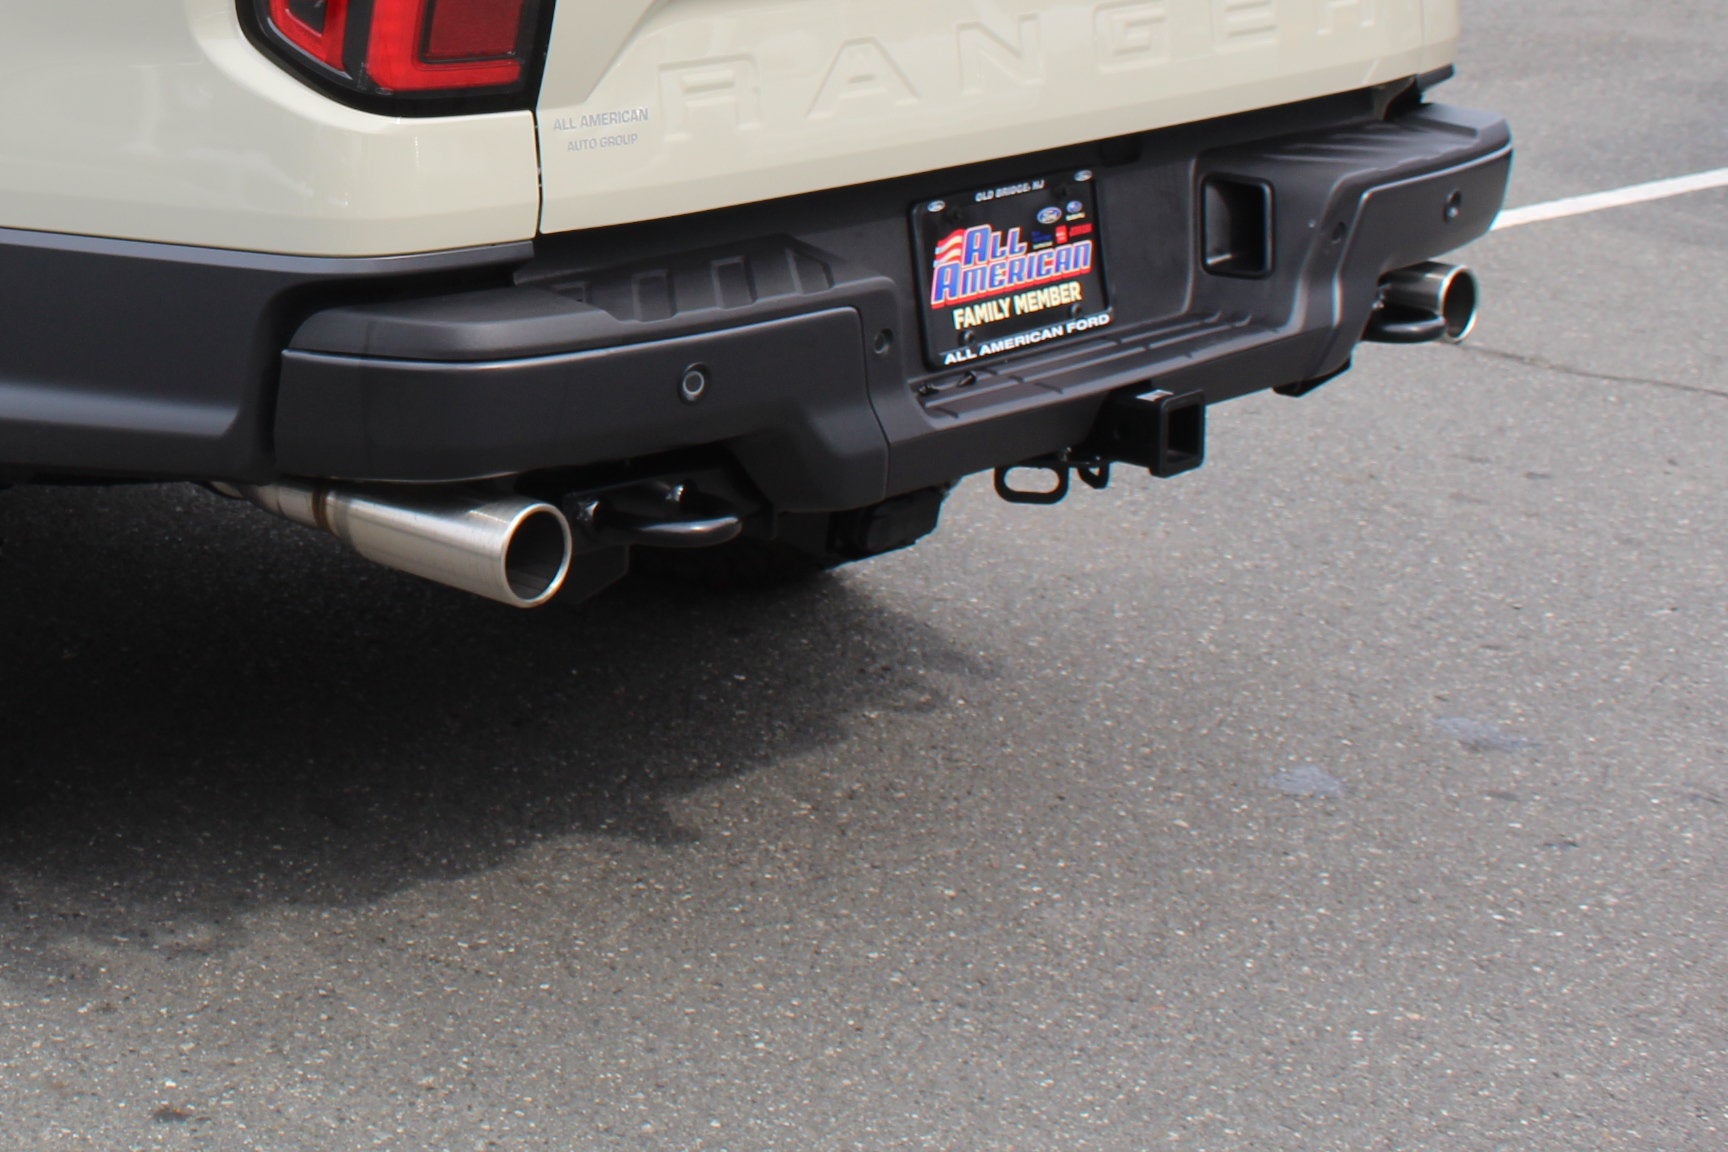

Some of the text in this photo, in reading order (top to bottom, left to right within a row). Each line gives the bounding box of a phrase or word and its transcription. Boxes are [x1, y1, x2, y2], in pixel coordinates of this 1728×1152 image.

[553, 107, 649, 131] ALL AMERICAN
[567, 133, 638, 152] AUTO GROUP
[975, 189, 994, 202] OLD
[1032, 178, 1045, 190] NJ
[953, 281, 1082, 330] FAMILY MEMBER
[944, 313, 1110, 365] ALL AMERICAN FORD
